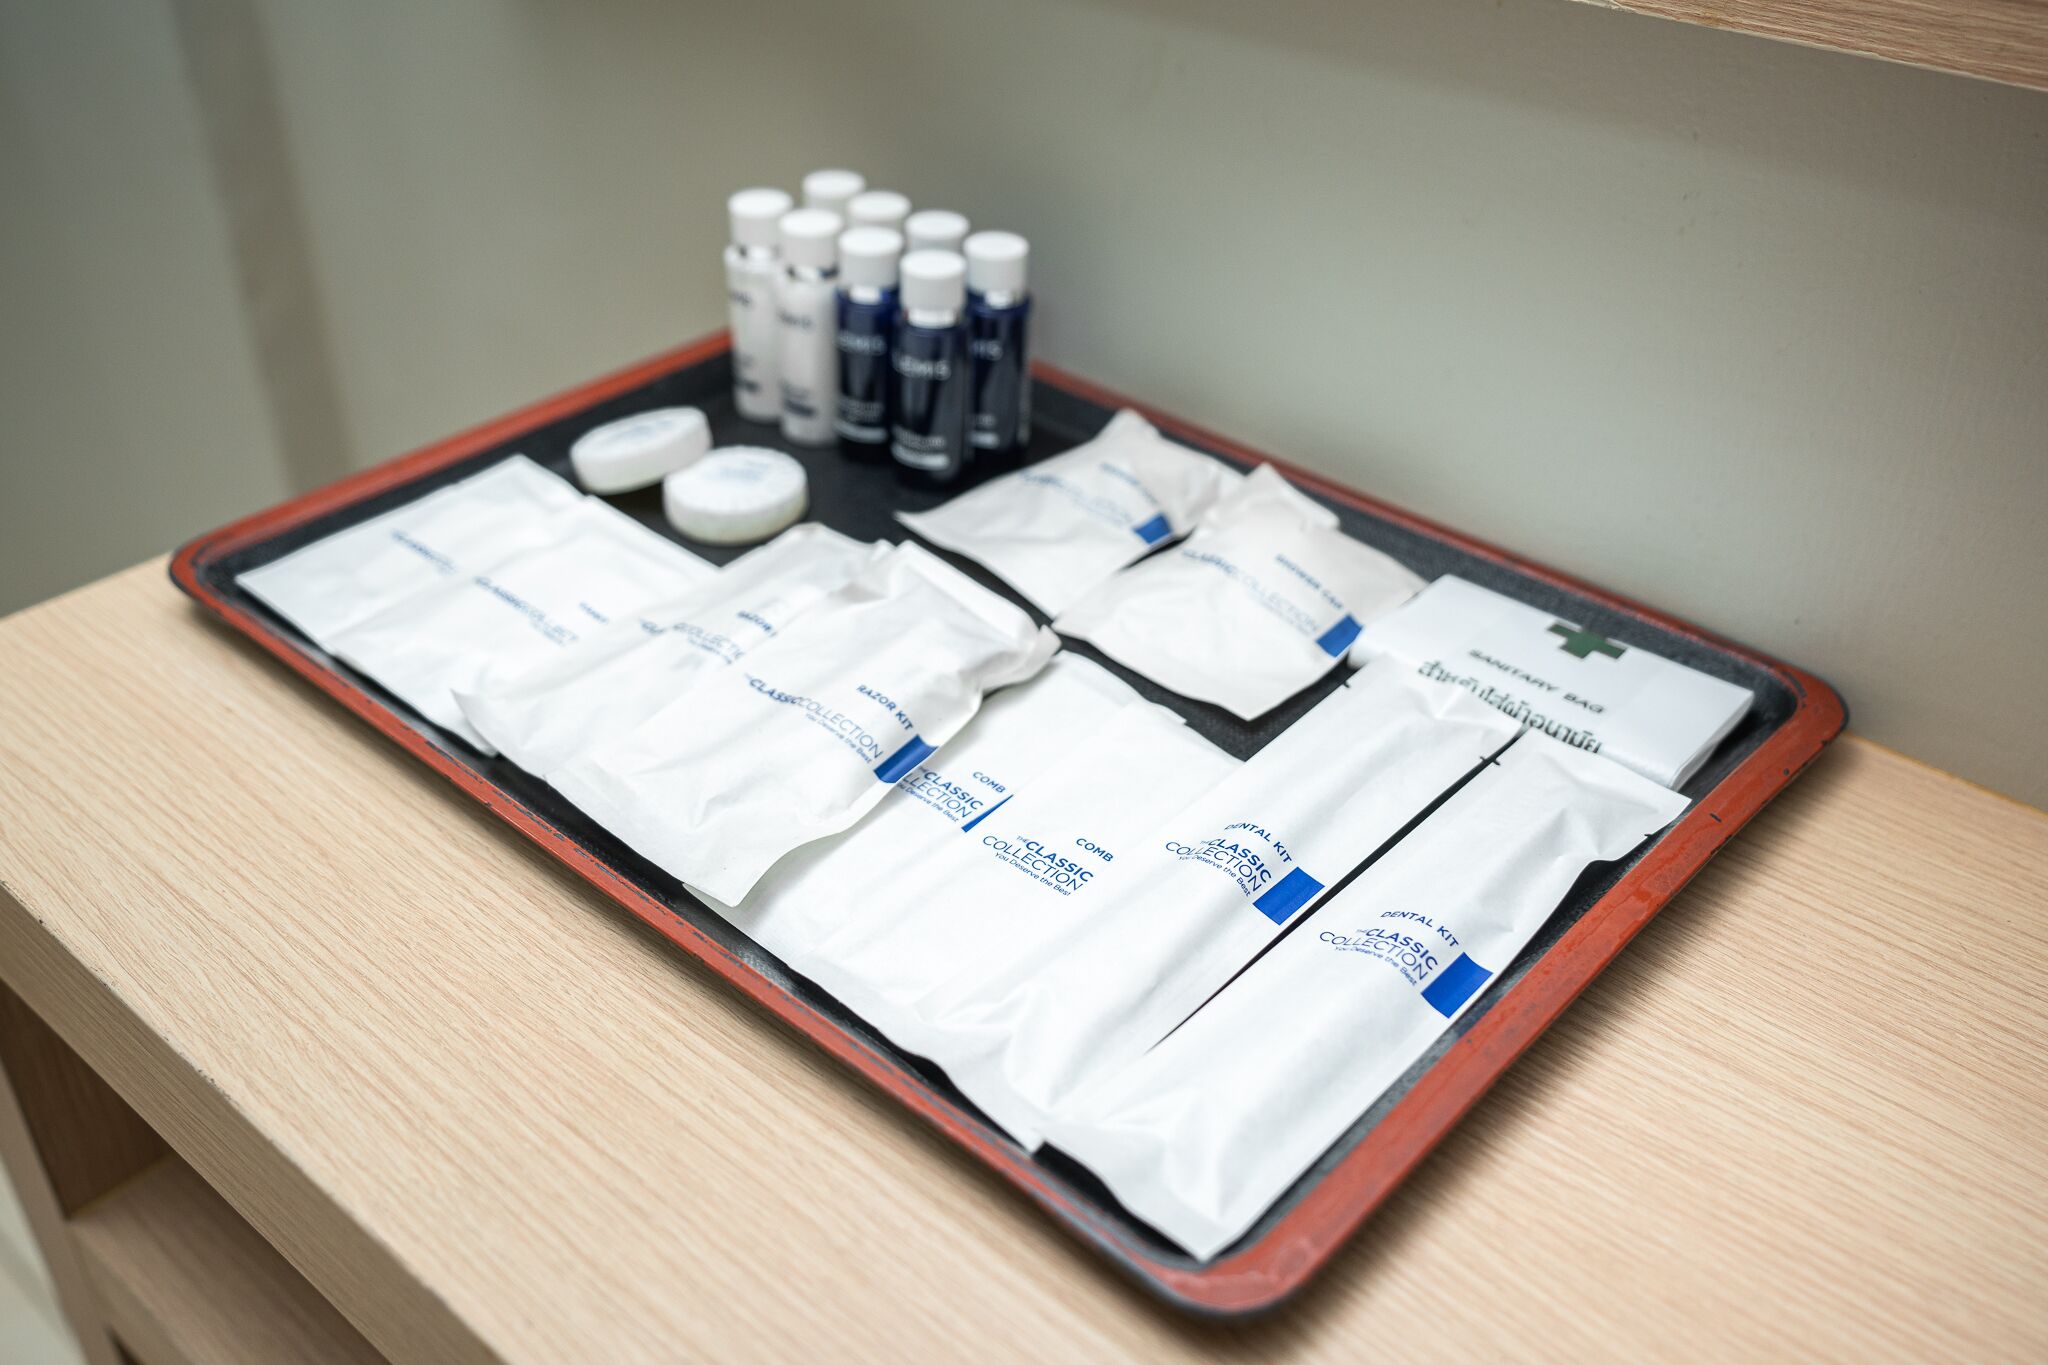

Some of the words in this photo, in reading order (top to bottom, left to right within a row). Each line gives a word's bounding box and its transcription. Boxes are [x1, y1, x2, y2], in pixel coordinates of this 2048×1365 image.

[1468, 649, 1559, 692] SANITARY
[1563, 692, 1606, 714] BAG
[797, 696, 885, 760] COLLECTION
[856, 684, 896, 711] RAZOR
[895, 710, 914, 731] KIT
[902, 773, 972, 818] LLECTION
[924, 771, 983, 810] CLASSIC
[973, 771, 1006, 793] COMB
[982, 835, 1084, 891] COLLECTION
[1025, 841, 1094, 883] CLASSIC
[1076, 838, 1114, 862] COMB
[1208, 838, 1272, 883] CLASSIC
[1224, 822, 1271, 842] DENTAL
[1273, 841, 1293, 863] KIT
[995, 852, 1009, 862] You
[1009, 858, 1040, 880] Deserve
[1039, 877, 1053, 887] the
[1053, 883, 1071, 897] Best
[1165, 841, 1262, 892] COLLECTION
[1191, 854, 1223, 870] Deserve
[1223, 866, 1237, 878] the
[1236, 876, 1251, 897] Best
[1365, 928, 1438, 971] CLASSIC
[1380, 911, 1433, 928] DENTAL
[1436, 925, 1459, 947] KIT
[1319, 931, 1428, 981] COLLECTION
[1347, 945, 1384, 959] Deserve
[1384, 956, 1400, 968] the
[1399, 966, 1418, 986] Best
